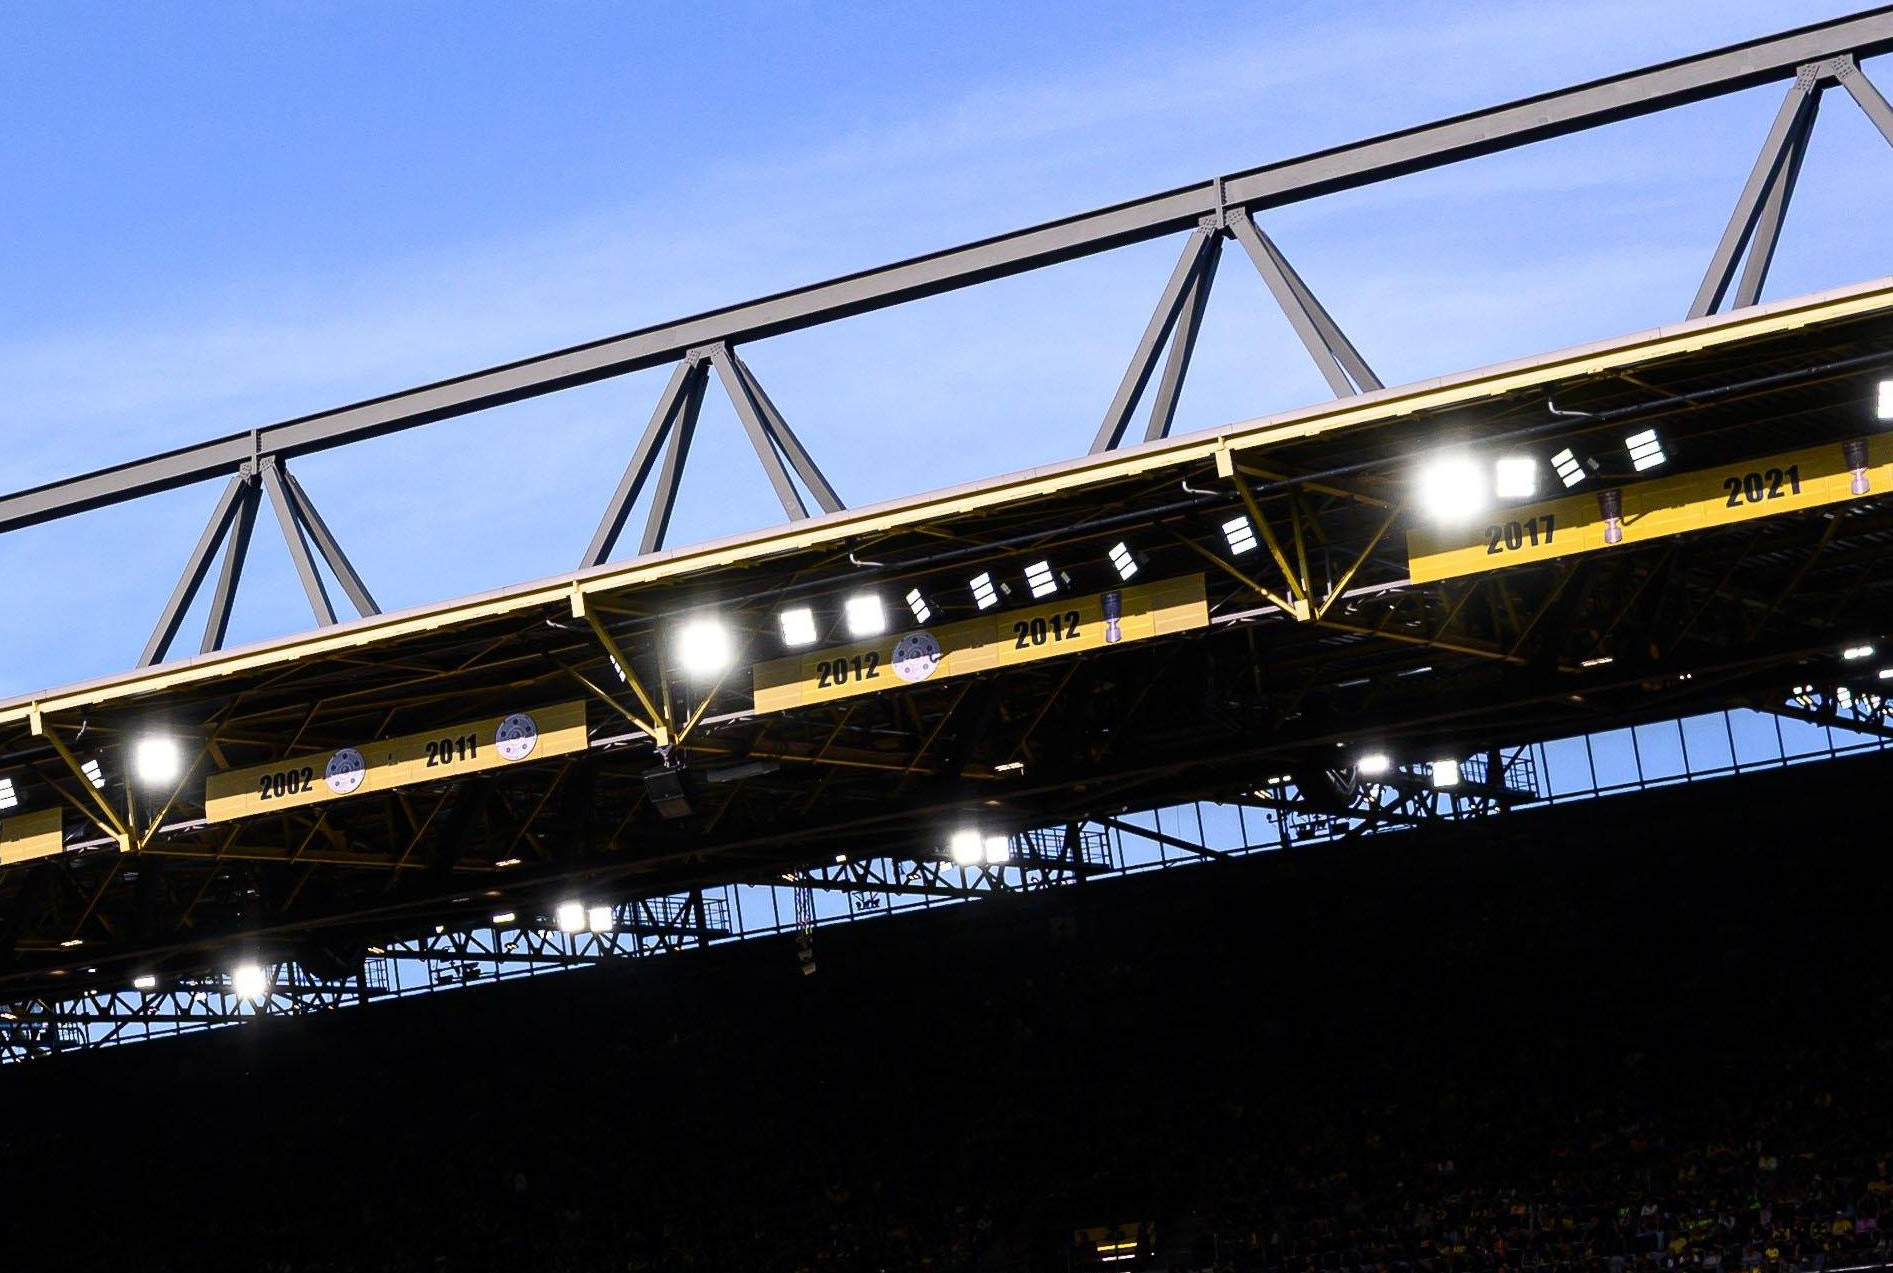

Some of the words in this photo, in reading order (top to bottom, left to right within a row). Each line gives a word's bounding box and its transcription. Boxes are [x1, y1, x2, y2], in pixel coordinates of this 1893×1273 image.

[1723, 464, 1801, 508] 2021
[1486, 514, 1555, 555] 2017
[1012, 610, 1081, 650] 2012
[816, 651, 880, 689] 2012
[426, 733, 477, 767] 2011
[259, 766, 313, 801] 2002
